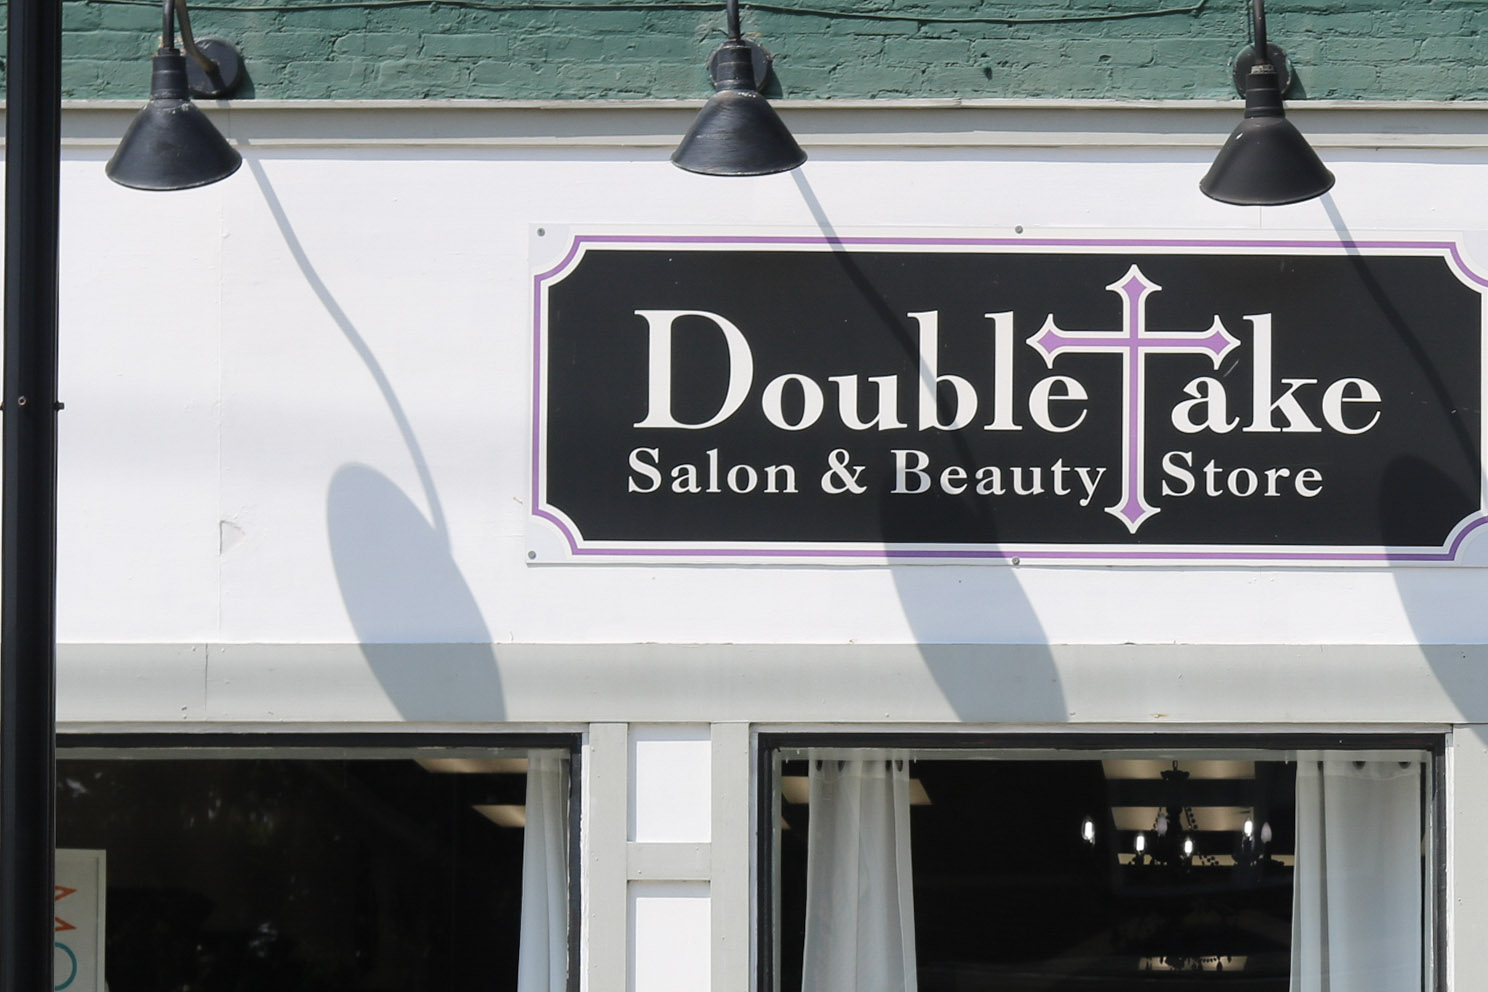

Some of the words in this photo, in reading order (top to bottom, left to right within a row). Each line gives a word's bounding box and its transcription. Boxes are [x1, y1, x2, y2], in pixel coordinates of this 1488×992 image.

[633, 310, 1089, 433] Double
[628, 447, 799, 493] Salon
[821, 448, 868, 495] &
[890, 449, 1107, 507] Beauty
[1161, 450, 1324, 498] Store
